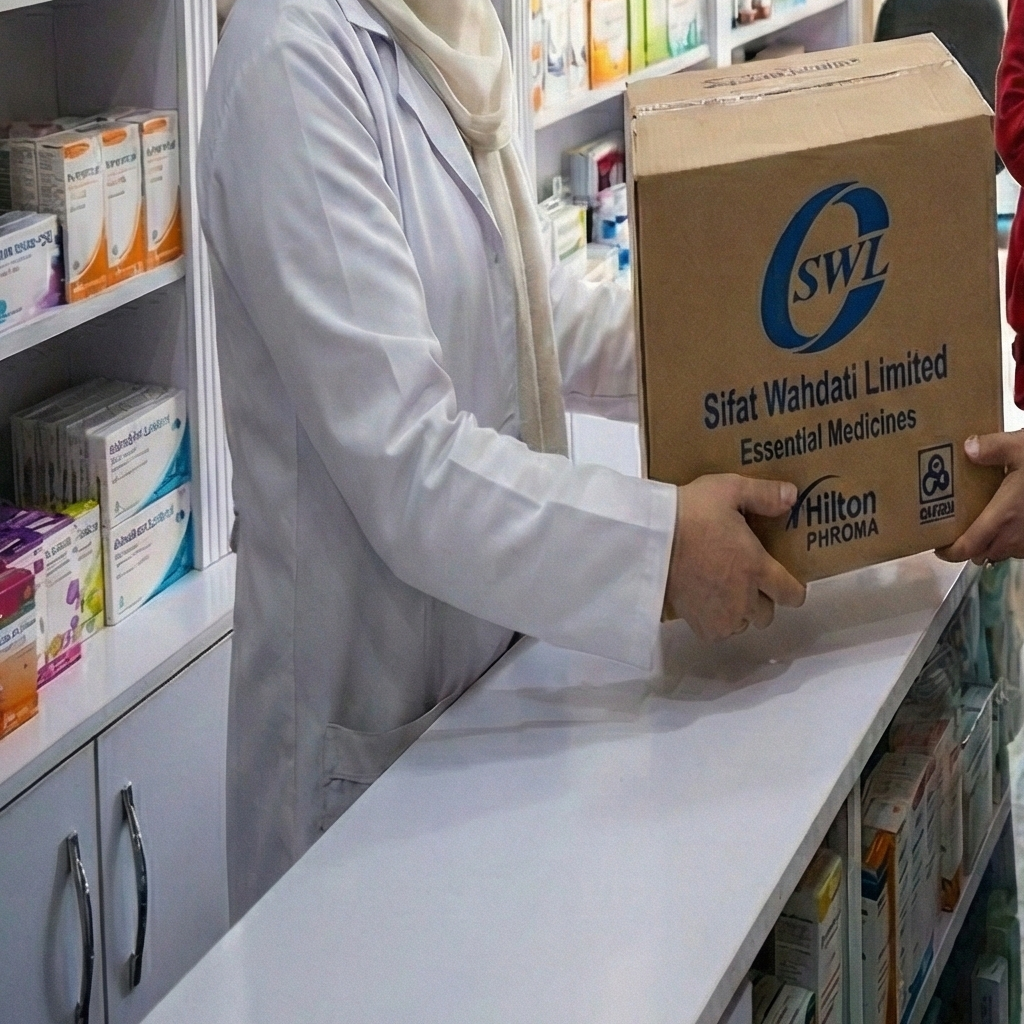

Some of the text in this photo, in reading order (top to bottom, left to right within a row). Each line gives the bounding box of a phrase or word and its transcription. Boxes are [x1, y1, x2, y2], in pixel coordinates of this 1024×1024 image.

[793, 233, 890, 304] SWL
[703, 344, 948, 430] Sifat Wahdati Limited
[828, 408, 917, 448] Medicines
[807, 490, 876, 527] Hilton
[807, 517, 879, 552] PHROMA
